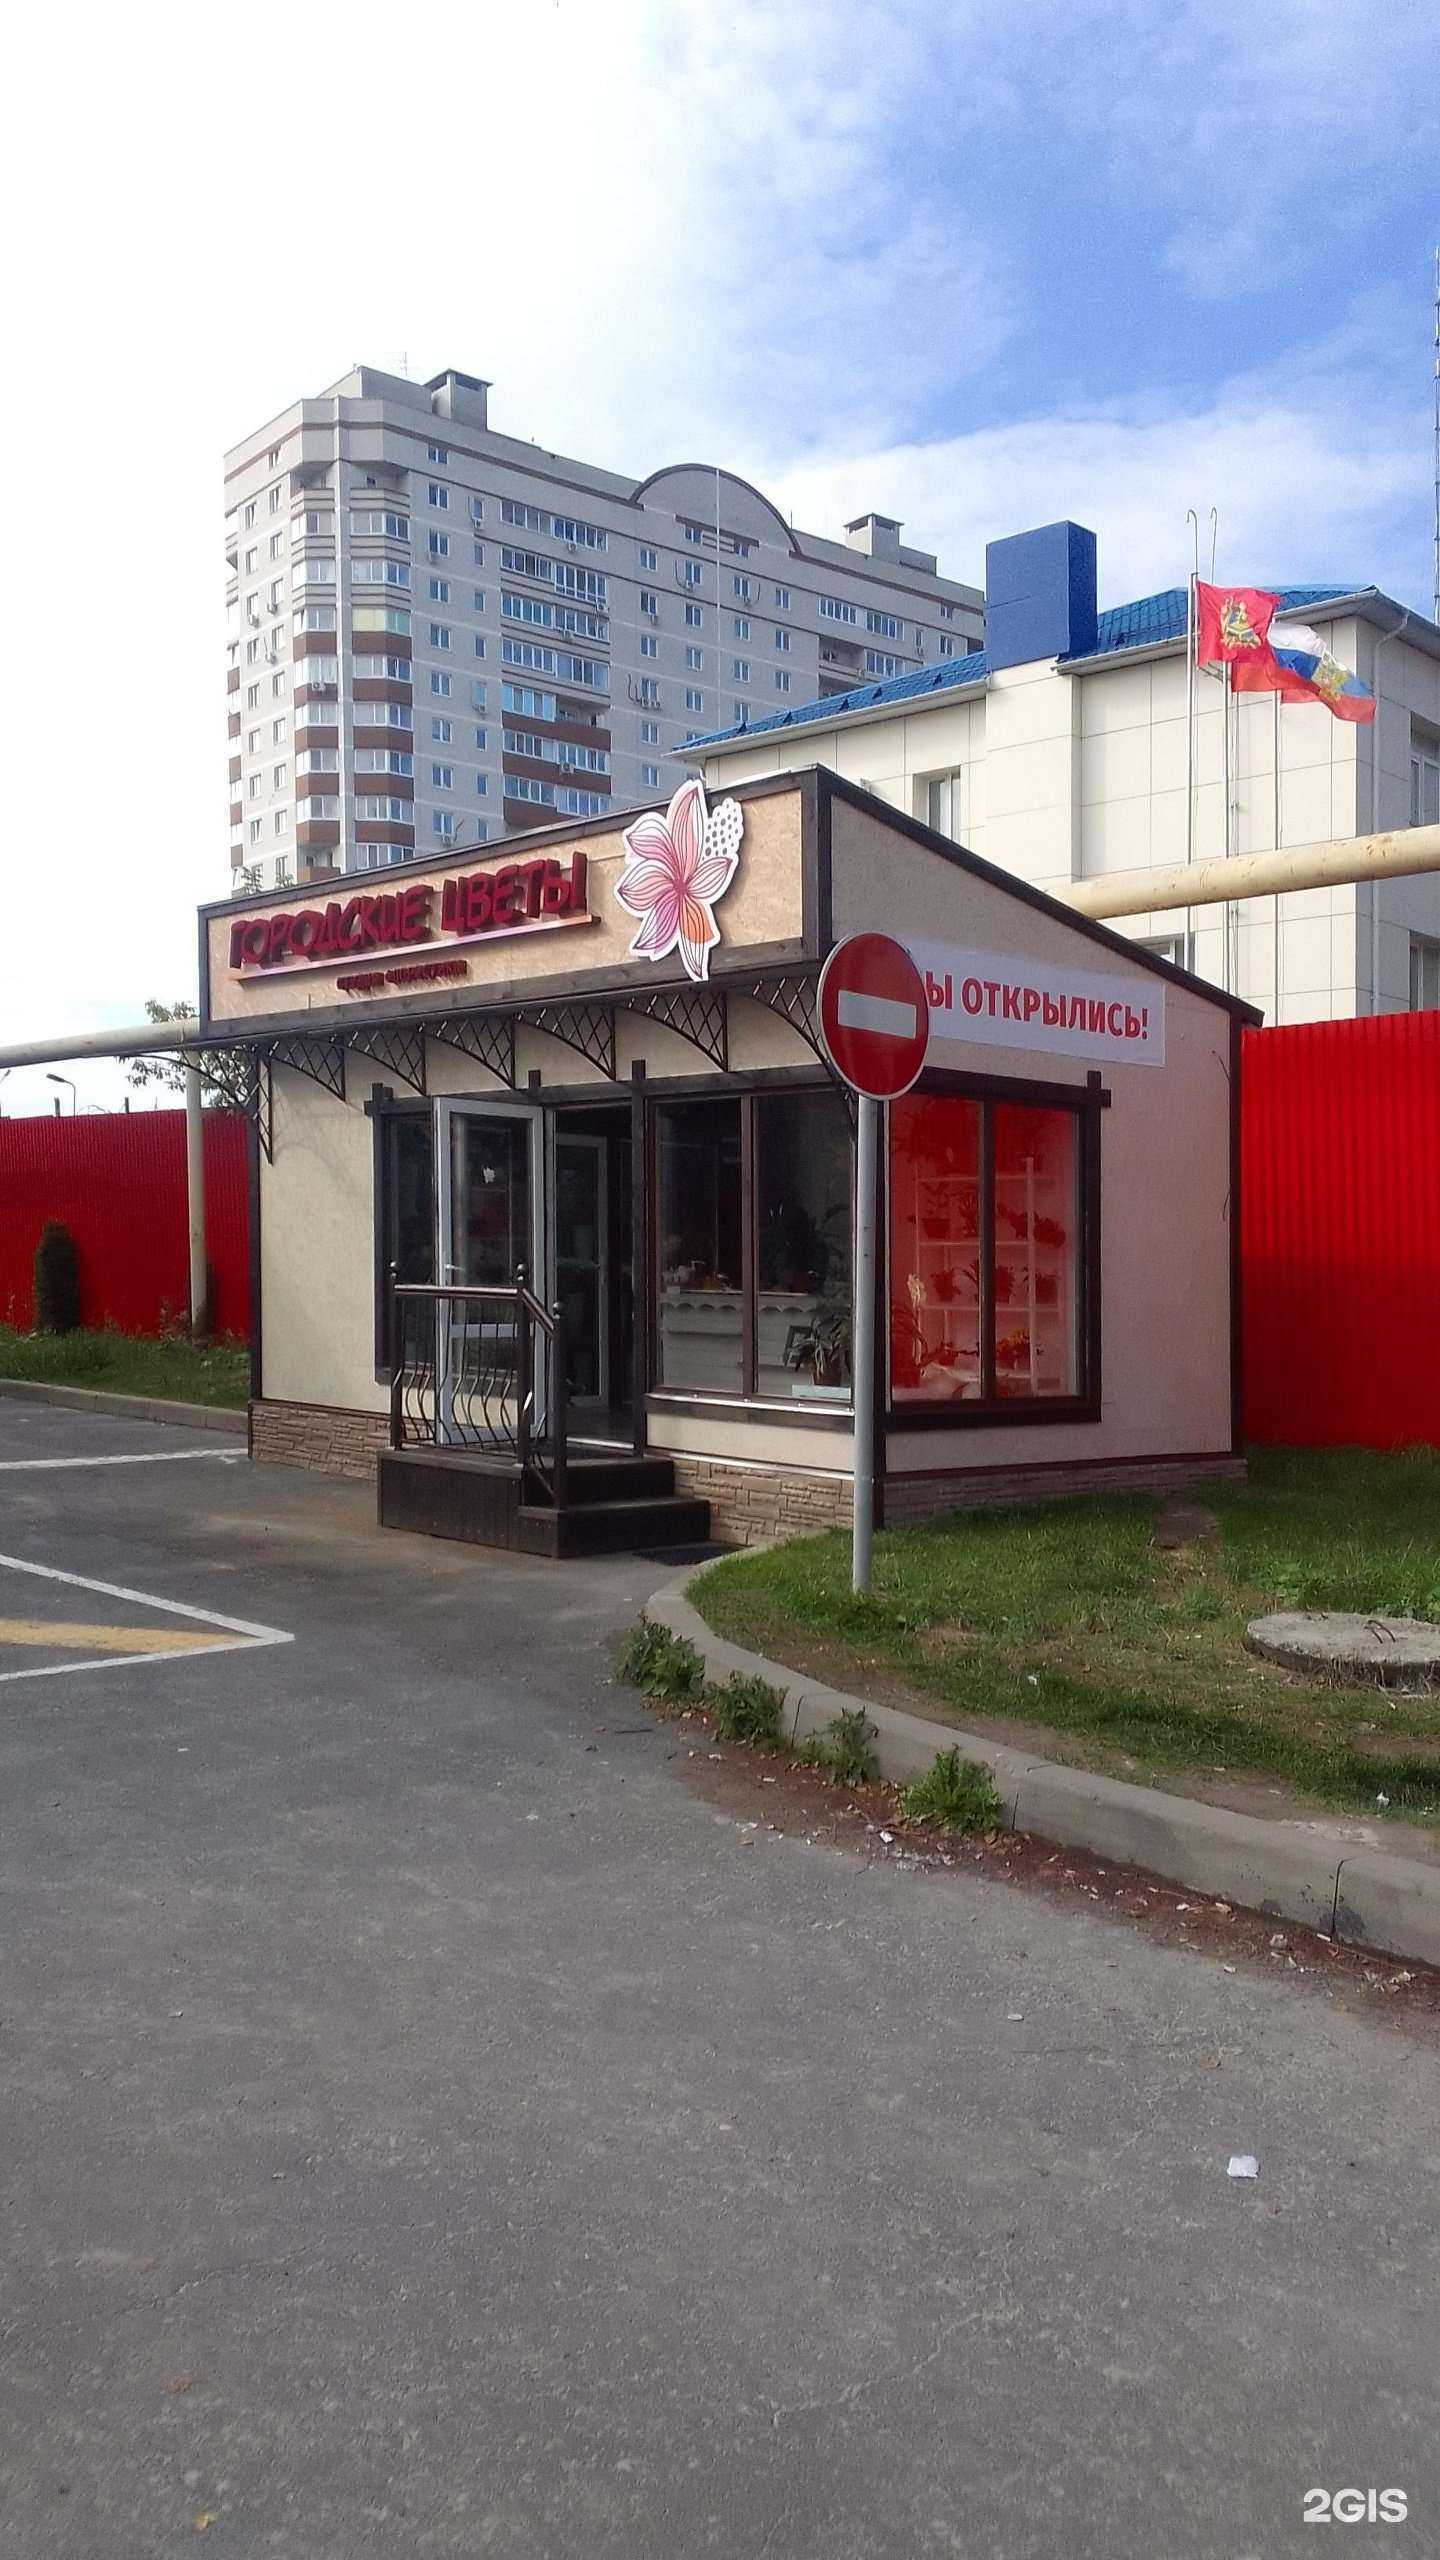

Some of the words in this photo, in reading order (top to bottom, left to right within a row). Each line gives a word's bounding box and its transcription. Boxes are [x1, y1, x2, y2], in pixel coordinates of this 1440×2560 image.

[230, 885, 433, 968] ГОРОДСКИЕ
[441, 851, 588, 936] ЦВЕТЫ
[925, 970, 953, 1010] Ы
[961, 977, 1148, 1040] ОТКРЫЛИСЬ!
